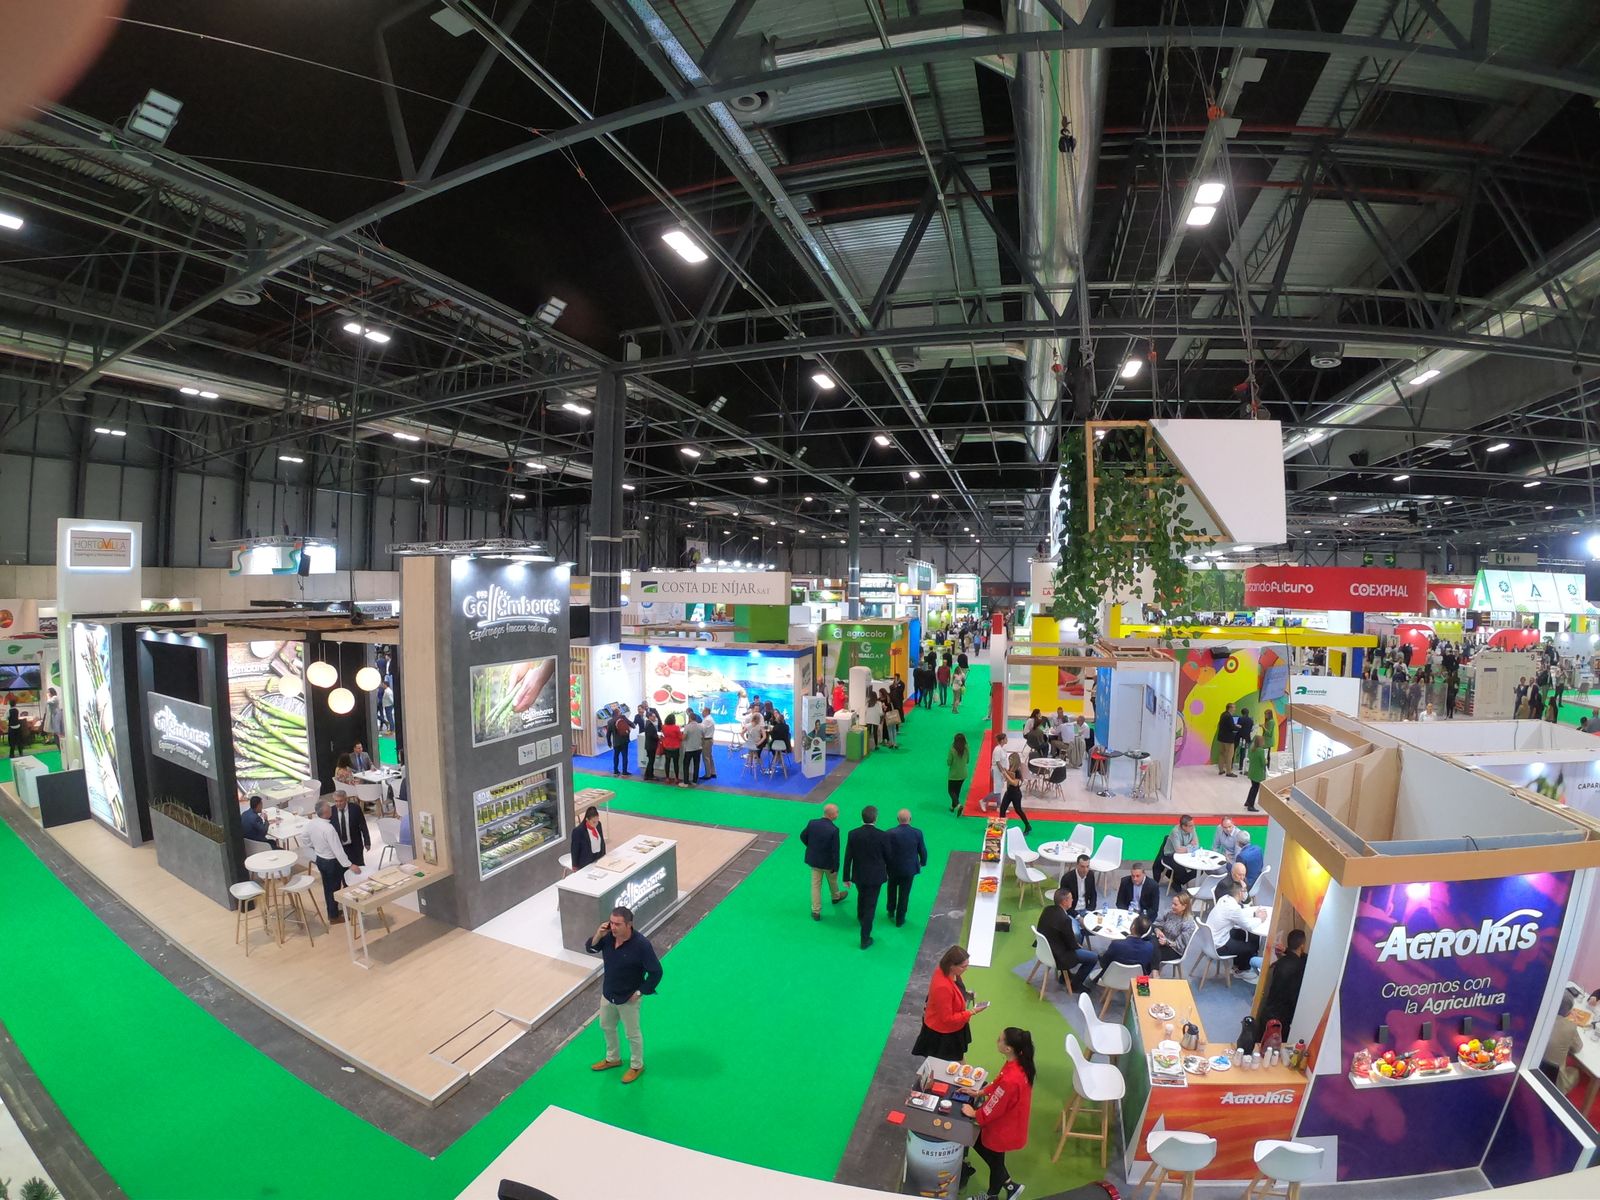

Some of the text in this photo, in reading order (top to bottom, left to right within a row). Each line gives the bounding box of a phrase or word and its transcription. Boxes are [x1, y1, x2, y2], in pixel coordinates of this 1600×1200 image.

[662, 582, 698, 593] COSTA
[702, 582, 718, 594] DE
[721, 580, 756, 596] NÍJAR
[1350, 583, 1408, 598] COEXPHAL
[846, 629, 887, 639] agrocolor
[1577, 782, 1600, 790] CAPAR
[1375, 909, 1543, 962] AGROIRIS
[1381, 976, 1491, 999] Crecemos con
[1404, 990, 1506, 1015] la Agricultura
[1220, 1089, 1296, 1104] AGROIRIS
